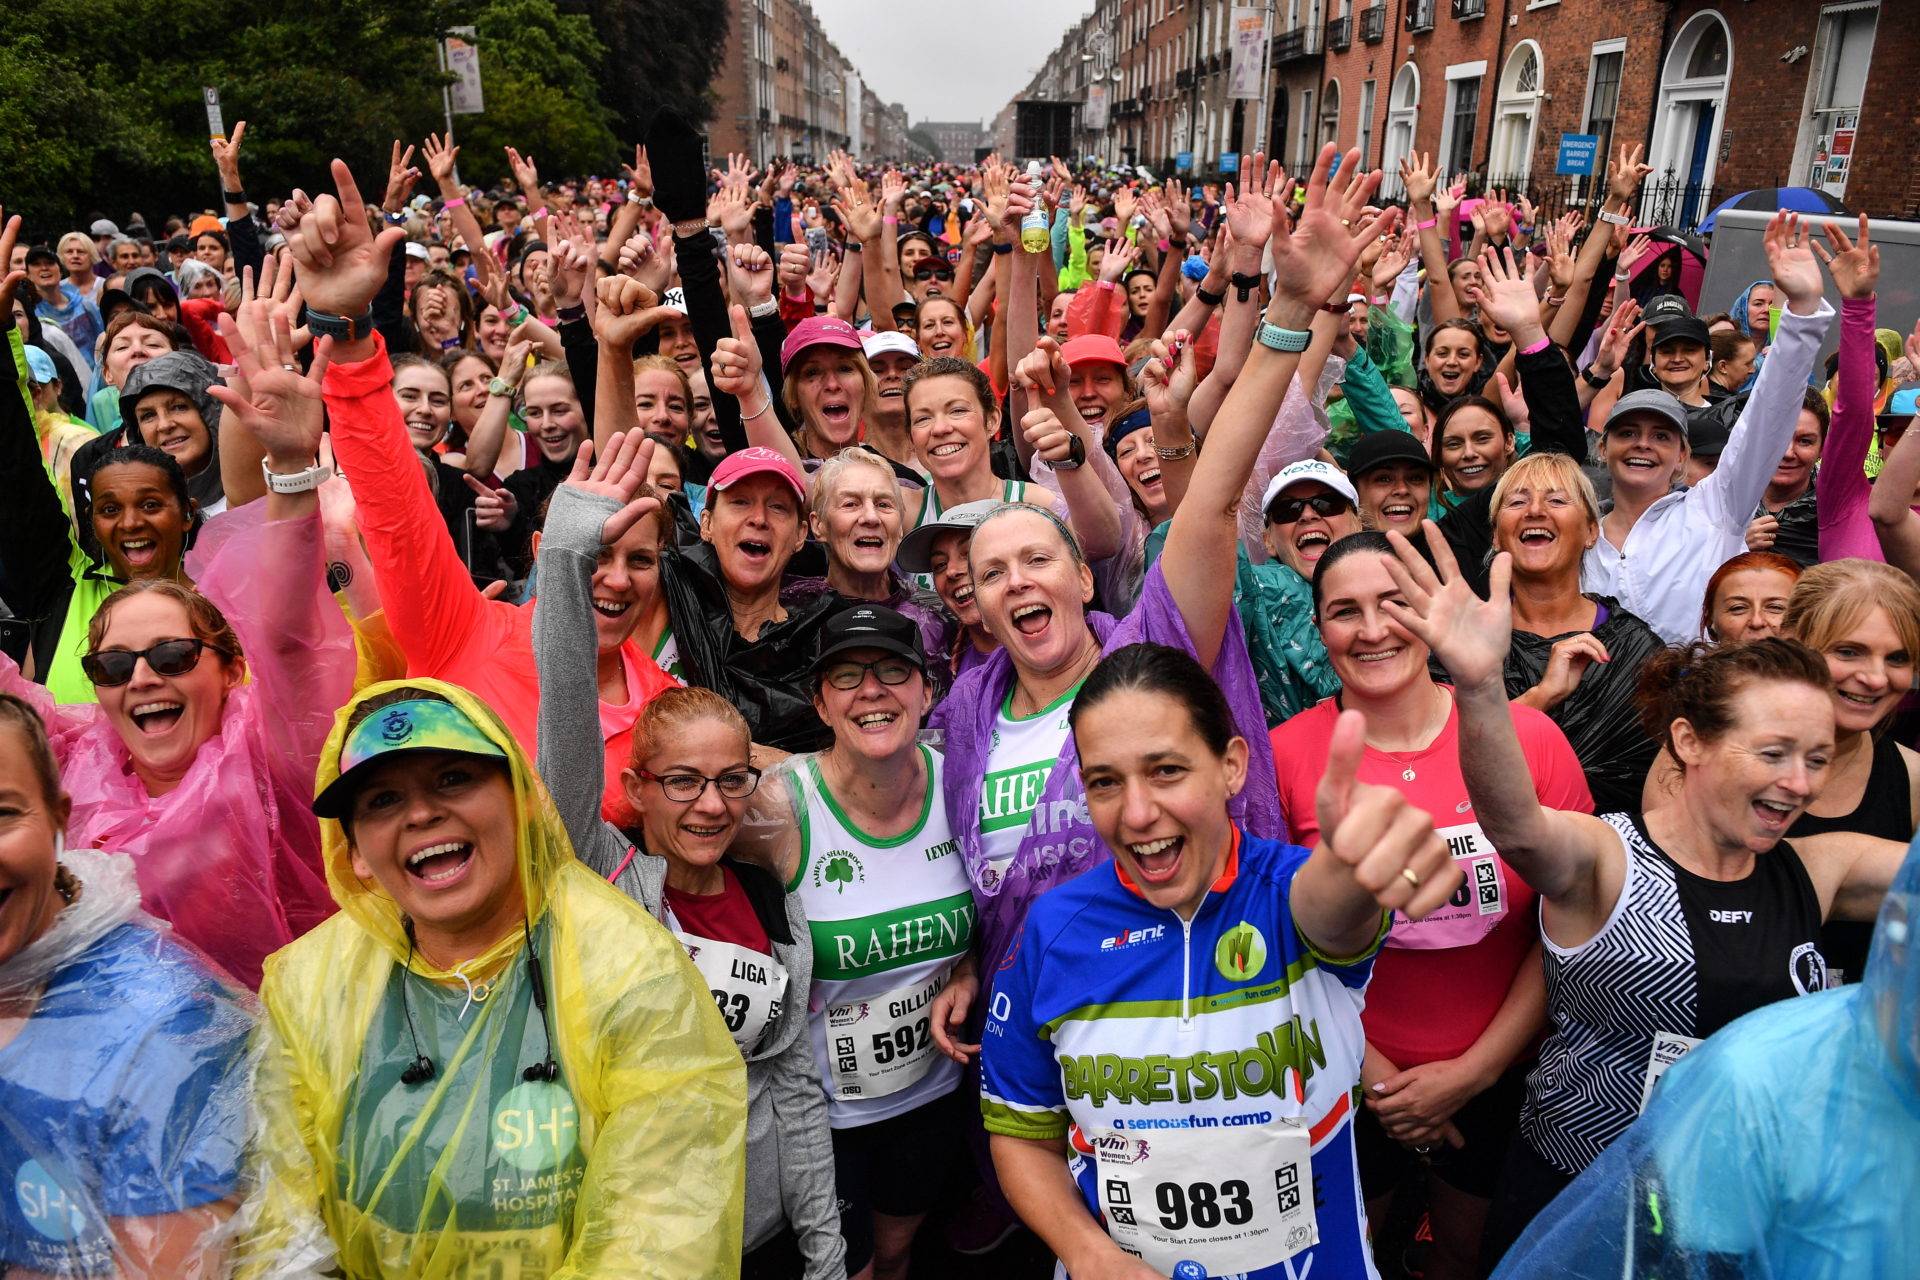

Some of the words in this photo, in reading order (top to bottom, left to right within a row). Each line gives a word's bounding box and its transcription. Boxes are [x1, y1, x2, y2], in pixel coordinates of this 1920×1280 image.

[1562, 140, 1597, 149] EMERGENCY
[1566, 150, 1590, 158] BARRIER
[1566, 159, 1585, 167] BREAK
[924, 839, 959, 861] LEYDE
[1446, 835, 1477, 856] HIE
[826, 849, 865, 871] SHAMROCK
[1709, 909, 1753, 924] DEFY
[833, 902, 976, 970] RAHENY
[730, 958, 768, 986] LIGA
[888, 976, 941, 1018] GILLIAN
[829, 1006, 851, 1018] Vhi
[1657, 1040, 1686, 1055] Vhi
[1059, 1014, 1327, 1107] BARRETSTOWN
[1113, 1118, 1125, 1130] a
[1222, 1110, 1272, 1127] camp
[1098, 1137, 1126, 1150] Vhi
[1100, 1150, 1131, 1161] Women's
[518, 1166, 583, 1191] JAMES'S
[494, 1186, 581, 1212] HOSPITA
[1155, 1179, 1254, 1231] 983
[1152, 1234, 1169, 1244] Your
[1169, 1236, 1188, 1245] Start
[1188, 1236, 1208, 1244] Zone
[1208, 1234, 1233, 1244] closes
[1243, 1227, 1270, 1239] 1:30pm
